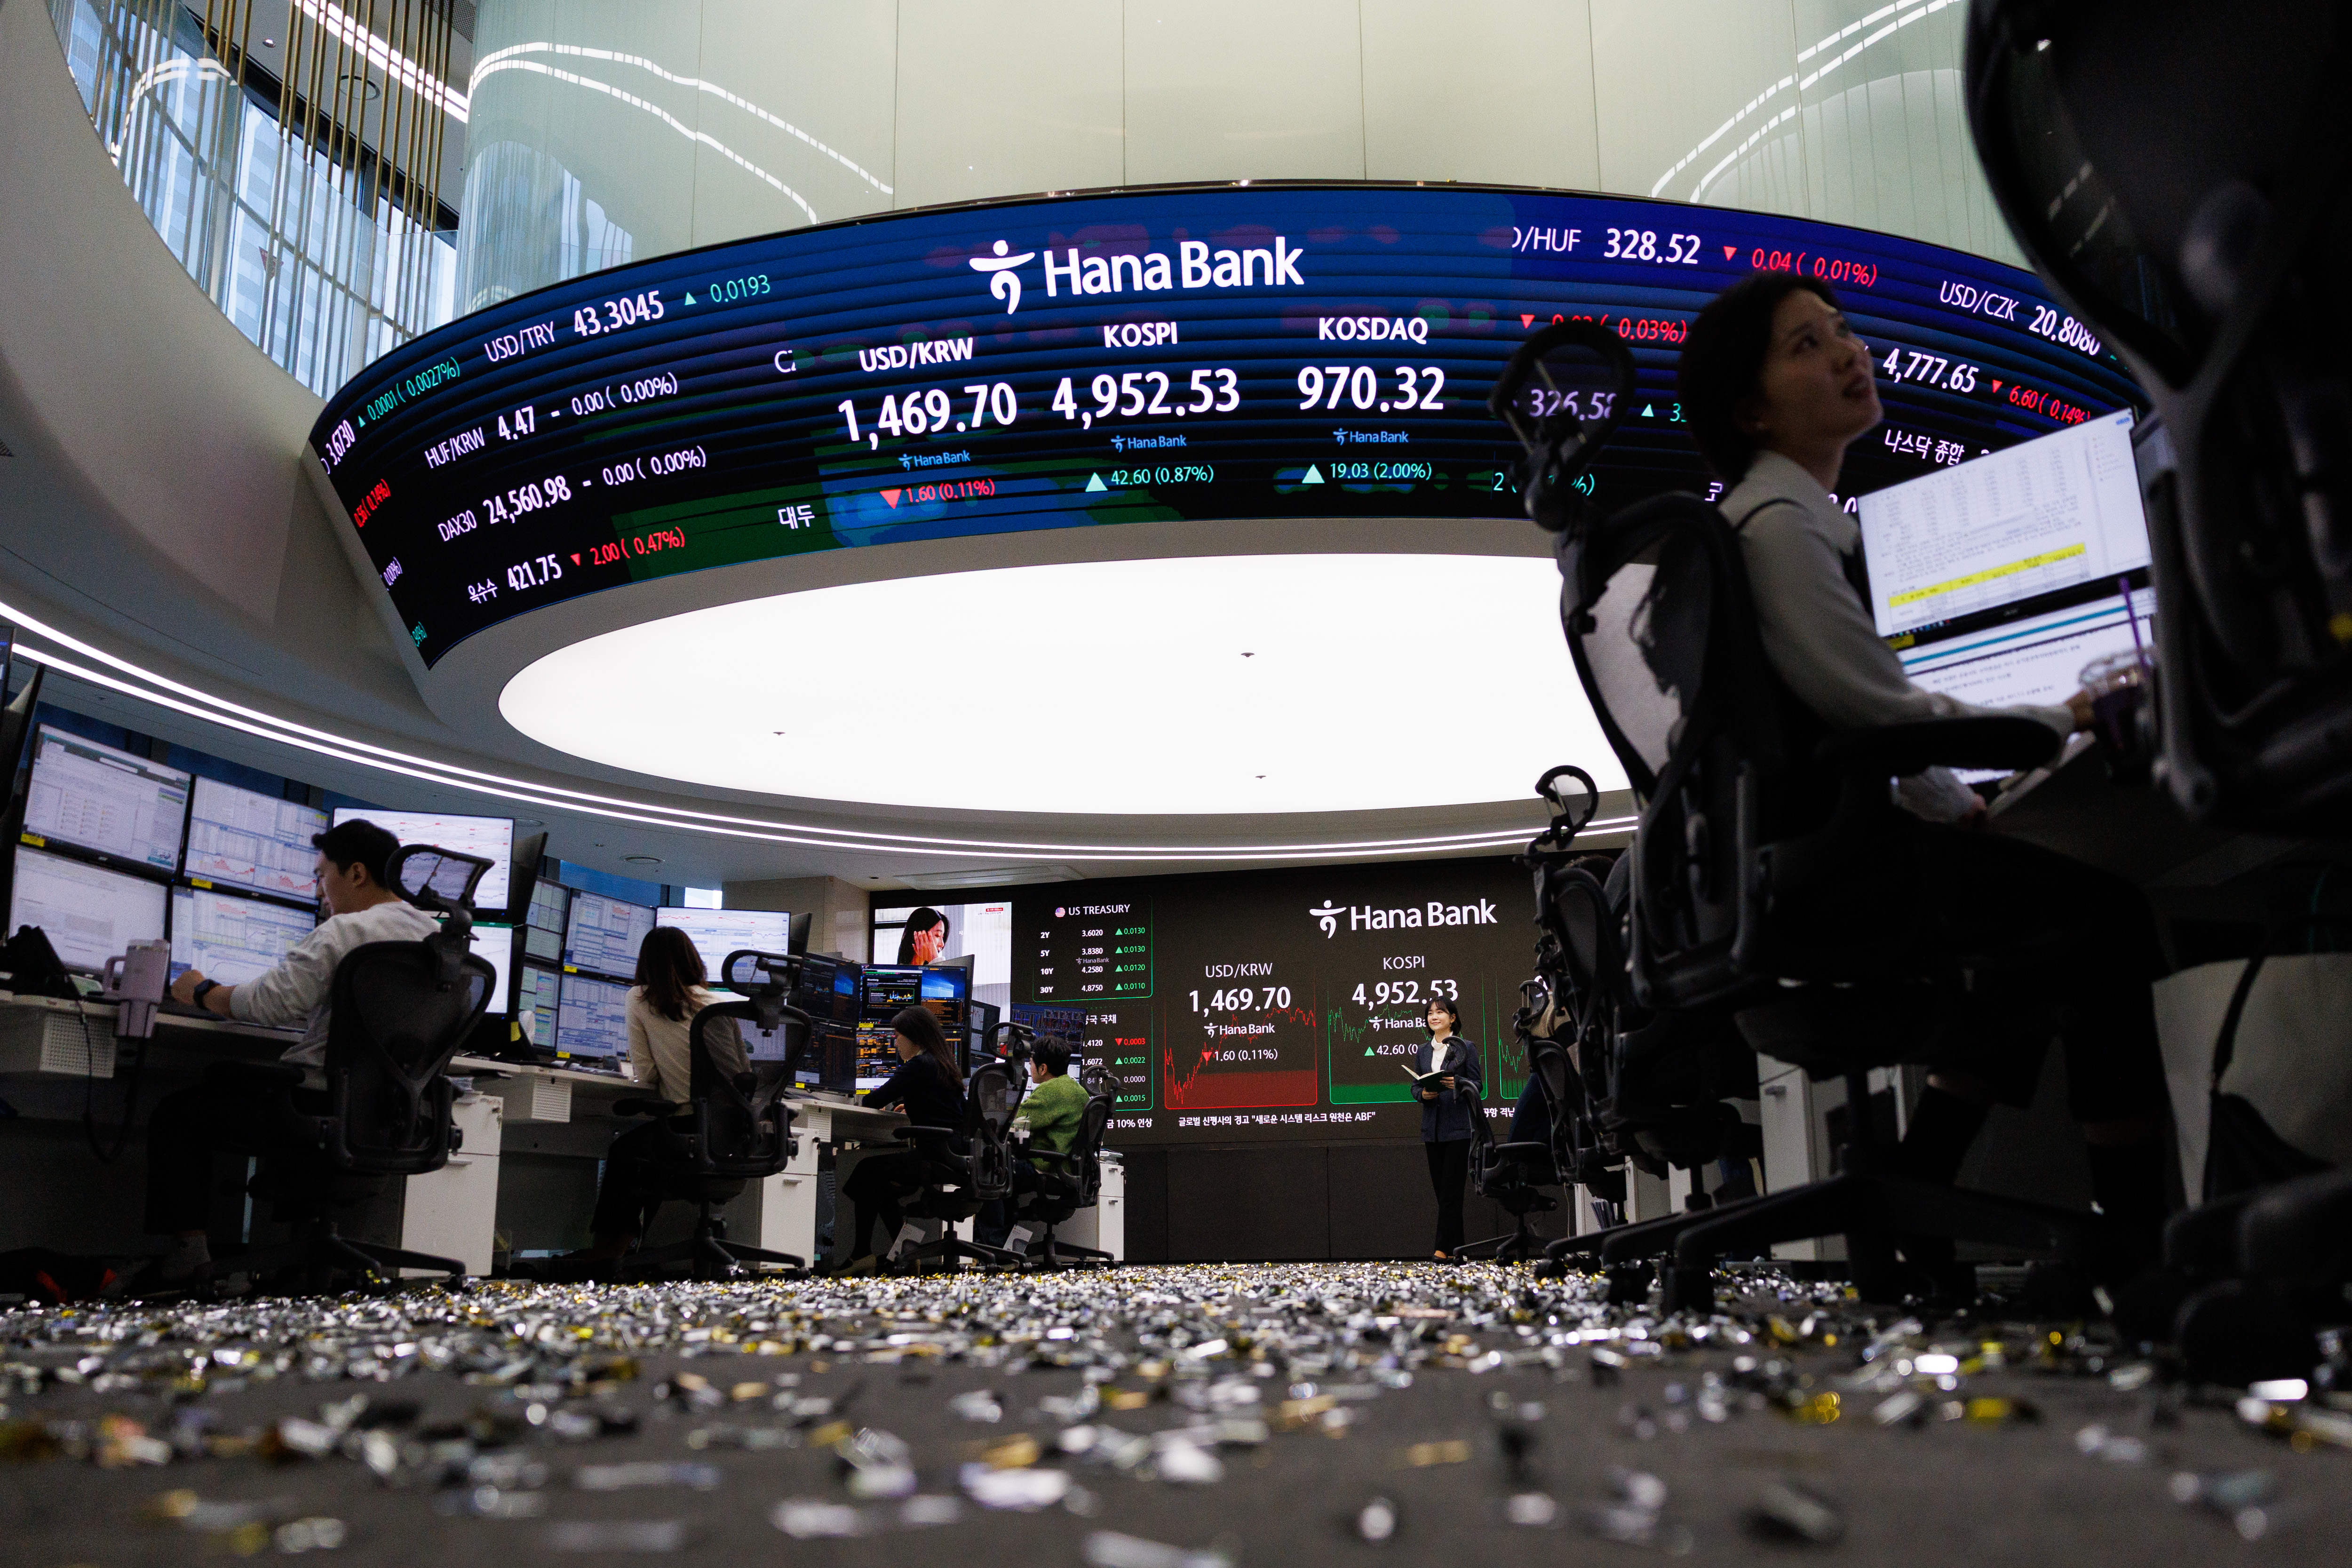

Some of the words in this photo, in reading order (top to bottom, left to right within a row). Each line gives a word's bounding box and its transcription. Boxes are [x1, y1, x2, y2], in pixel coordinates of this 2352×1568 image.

[1604, 228, 1700, 264] 328.52
[1043, 248, 1173, 297] Hana
[1180, 236, 1304, 288] Bank
[1940, 280, 2019, 321] USD/CZK
[484, 321, 555, 362] USD/TRY
[574, 290, 664, 336] 43.3045
[710, 274, 771, 302] 0.0193
[1319, 317, 1428, 345] KOSDAQ
[1104, 321, 1178, 348] KOSPI
[858, 337, 973, 372] USD/KRW
[1883, 348, 1979, 393] 4,777.65
[1052, 368, 1240, 430] 4,952.53
[1297, 366, 1445, 413] 970.32
[838, 382, 1017, 450] 1,469.70
[326, 420, 355, 466] 3.6730
[424, 427, 485, 469] HUF/KRW
[498, 406, 535, 440] 4.47
[1128, 437, 1157, 449] Hana
[1159, 434, 1186, 447] Bank
[1350, 431, 1379, 443] Hana
[1381, 431, 1408, 443] Bank
[1884, 429, 1932, 459] 나스닥
[1935, 440, 1965, 466] 종합
[914, 455, 943, 467] Hana
[943, 450, 970, 463] Bank
[1330, 463, 1369, 479] 19.03
[1374, 462, 1432, 480] (2.00%)
[1111, 469, 1151, 486] 42.60
[1155, 464, 1214, 485] (0.87%)
[906, 485, 936, 503] 1.60
[938, 478, 995, 501] (0.11%)
[437, 509, 477, 541] DAX30
[482, 475, 572, 524] 24,560.98
[778, 505, 815, 529] 대두
[468, 578, 498, 604] 옥수수
[508, 554, 562, 591] 421.75
[1068, 907, 1081, 915] US
[1082, 904, 1130, 915] TREASURY
[1351, 905, 1422, 931] Hana
[1427, 898, 1498, 927] Bank
[1205, 963, 1273, 979] USD/KRW
[1383, 955, 1425, 970] KOSPI
[1189, 987, 1291, 1018] 1,469.70
[1352, 979, 1458, 1011] 4,952.53
[1100, 1014, 1117, 1024] 국채
[1219, 1025, 1247, 1035] Hana
[1248, 1023, 1275, 1034] Bank
[1385, 1018, 1414, 1029] Hana
[1414, 1017, 1427, 1028] Ba
[1123, 1037, 1145, 1046] 0.0003
[1214, 1050, 1235, 1061] 1.60
[1238, 1048, 1278, 1061] (0.11%)
[1376, 1044, 1405, 1055] 42.60
[1081, 1058, 1103, 1067] 1.6072
[1116, 1119, 1136, 1128] 10%
[1137, 1118, 1153, 1128] 인상
[1178, 1116, 1200, 1127] 글로벌
[1202, 1115, 1232, 1126] 신평사의
[1234, 1115, 1249, 1125] 경고
[1251, 1114, 1278, 1124] "새로운
[1279, 1114, 1303, 1124] 시스템
[1304, 1113, 1328, 1123] 리스크
[1329, 1112, 1353, 1122] 원천은
[1354, 1111, 1376, 1121] ABF"
